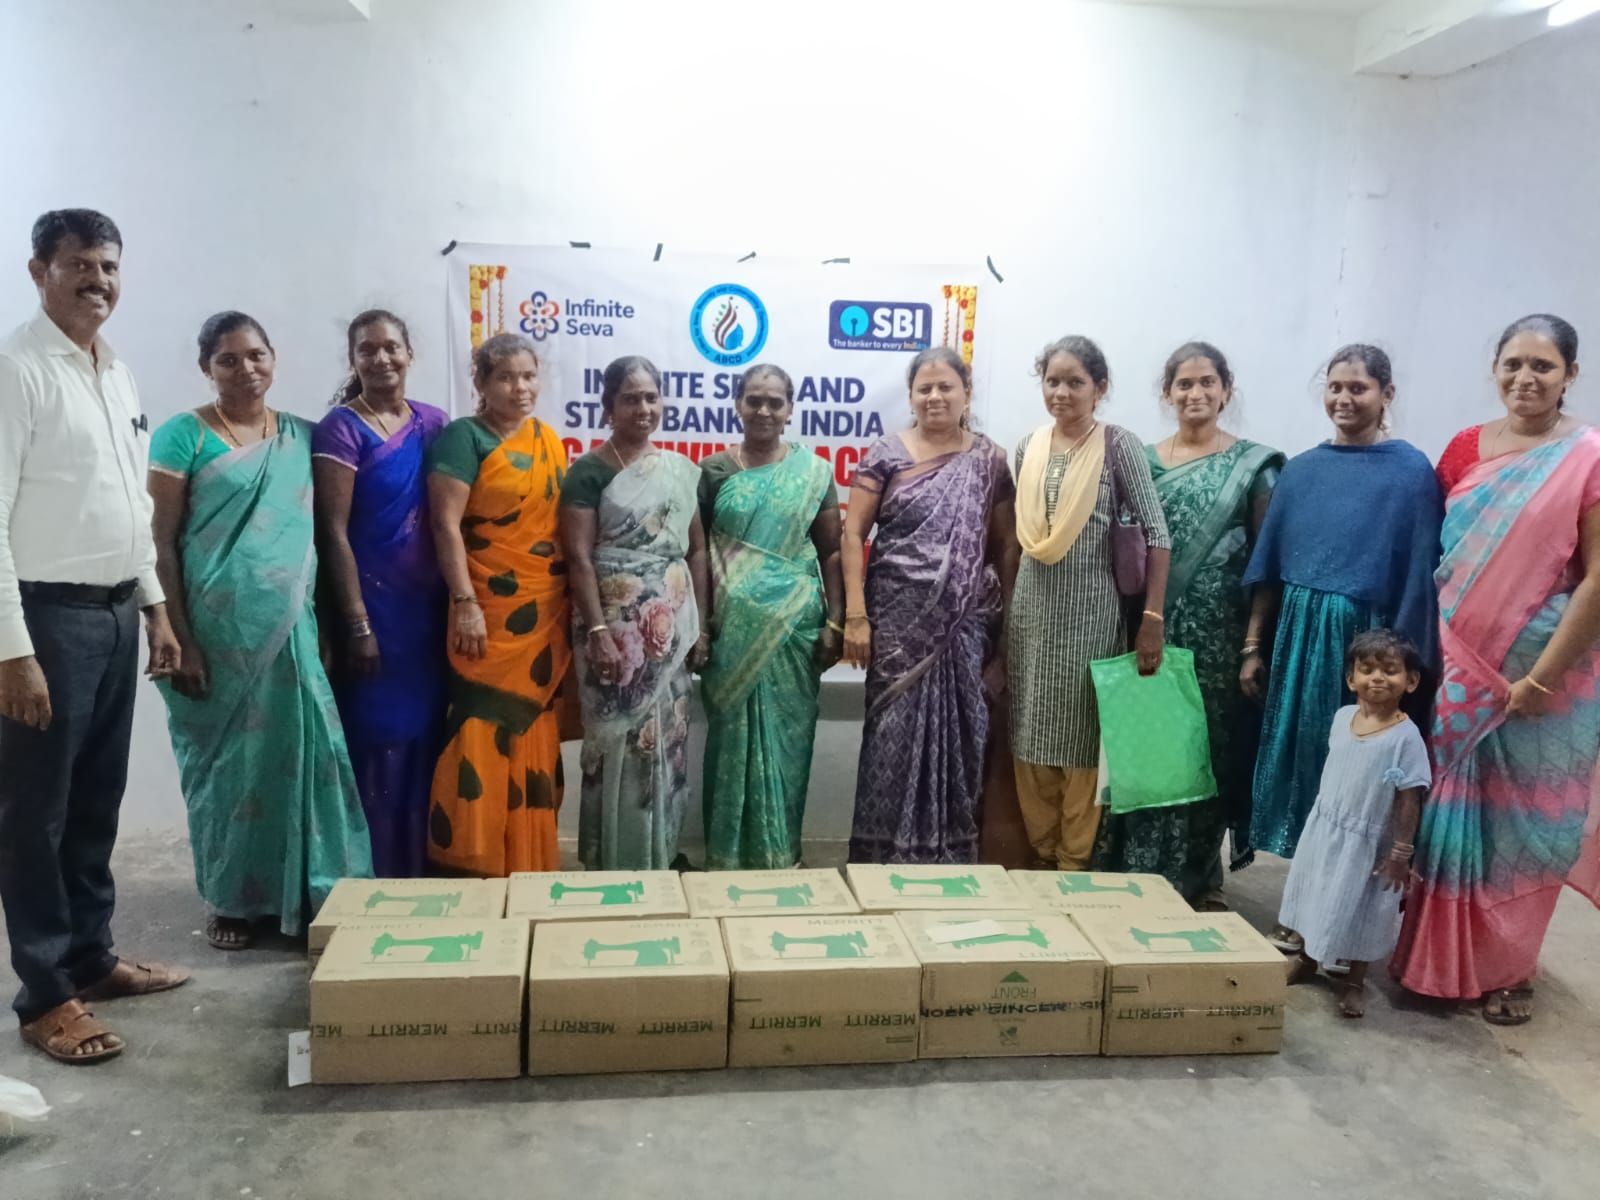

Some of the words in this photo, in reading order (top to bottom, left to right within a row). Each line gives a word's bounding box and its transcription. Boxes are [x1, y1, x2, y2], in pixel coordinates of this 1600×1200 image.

[565, 299, 635, 318] Infinite
[566, 318, 614, 337] Seva
[872, 307, 924, 339] SBI
[833, 339, 846, 348] The
[847, 340, 872, 349] banker
[882, 342, 902, 351] every
[714, 353, 743, 365] ABCD
[584, 368, 704, 399] INITE
[797, 376, 865, 403] AND
[661, 406, 744, 434] BANK
[801, 410, 884, 437] INDIA
[991, 987, 1036, 999] FRONT
[1116, 1007, 1185, 1020] MERRITT
[1206, 1004, 1275, 1018] MERRITT
[539, 1020, 615, 1034] MERRITT
[638, 1020, 713, 1034] MERRITT
[750, 1015, 822, 1030] MERRITT
[845, 1013, 916, 1027] MERRITT
[368, 1023, 448, 1037] MERRITT
